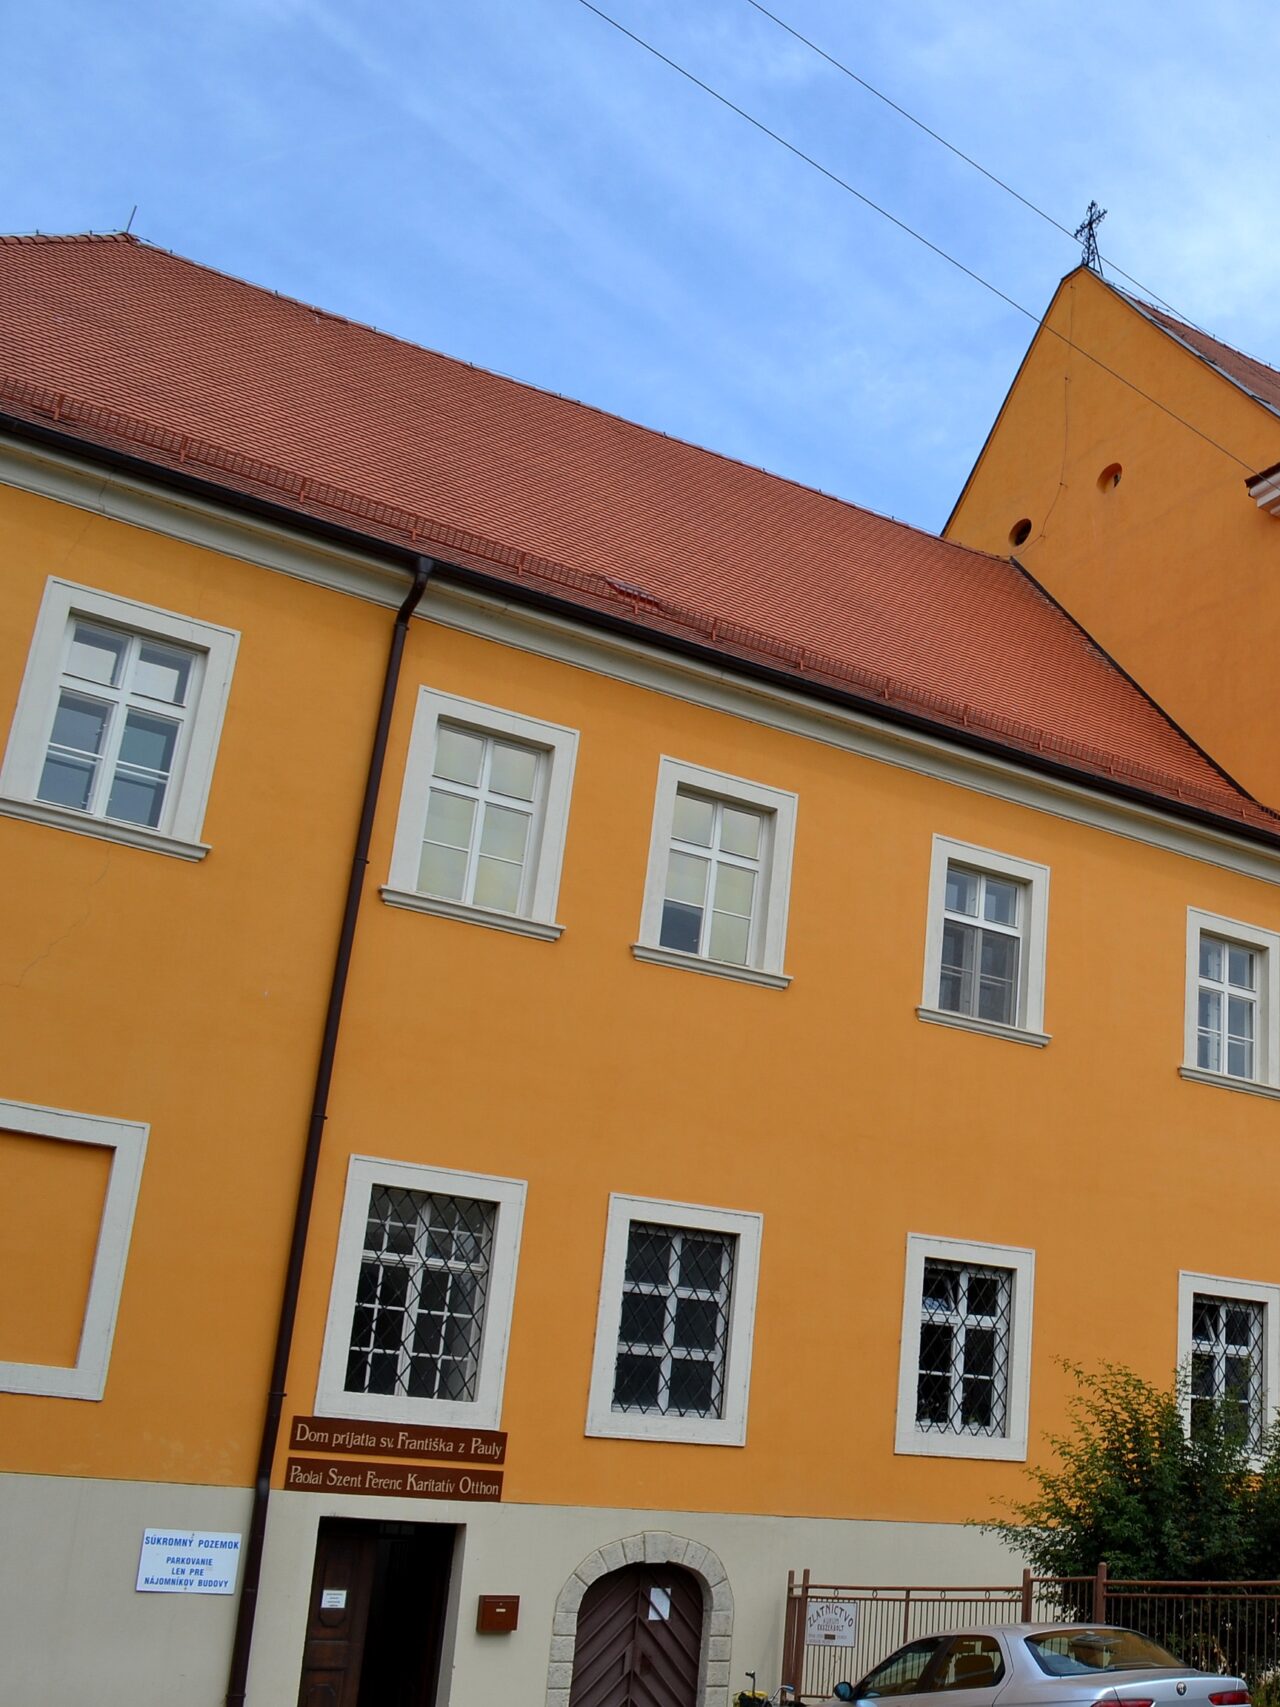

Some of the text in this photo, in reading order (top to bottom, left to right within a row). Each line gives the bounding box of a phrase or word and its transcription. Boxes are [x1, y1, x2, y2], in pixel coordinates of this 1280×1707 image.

[296, 1424, 503, 1460] Dom prijatia sv. Františka z Pauly
[289, 1466, 499, 1496] Paolai Szent Ferenc Karitatív Otthon
[144, 1534, 239, 1550] SÚKROMNÝ POZEMOK
[166, 1556, 213, 1566] PARKOVANIE
[171, 1567, 204, 1577] LEN PRE
[144, 1575, 229, 1589] NÁJOMNÍKOV BUDOVY
[808, 1603, 853, 1627] ZLATNICTVO
